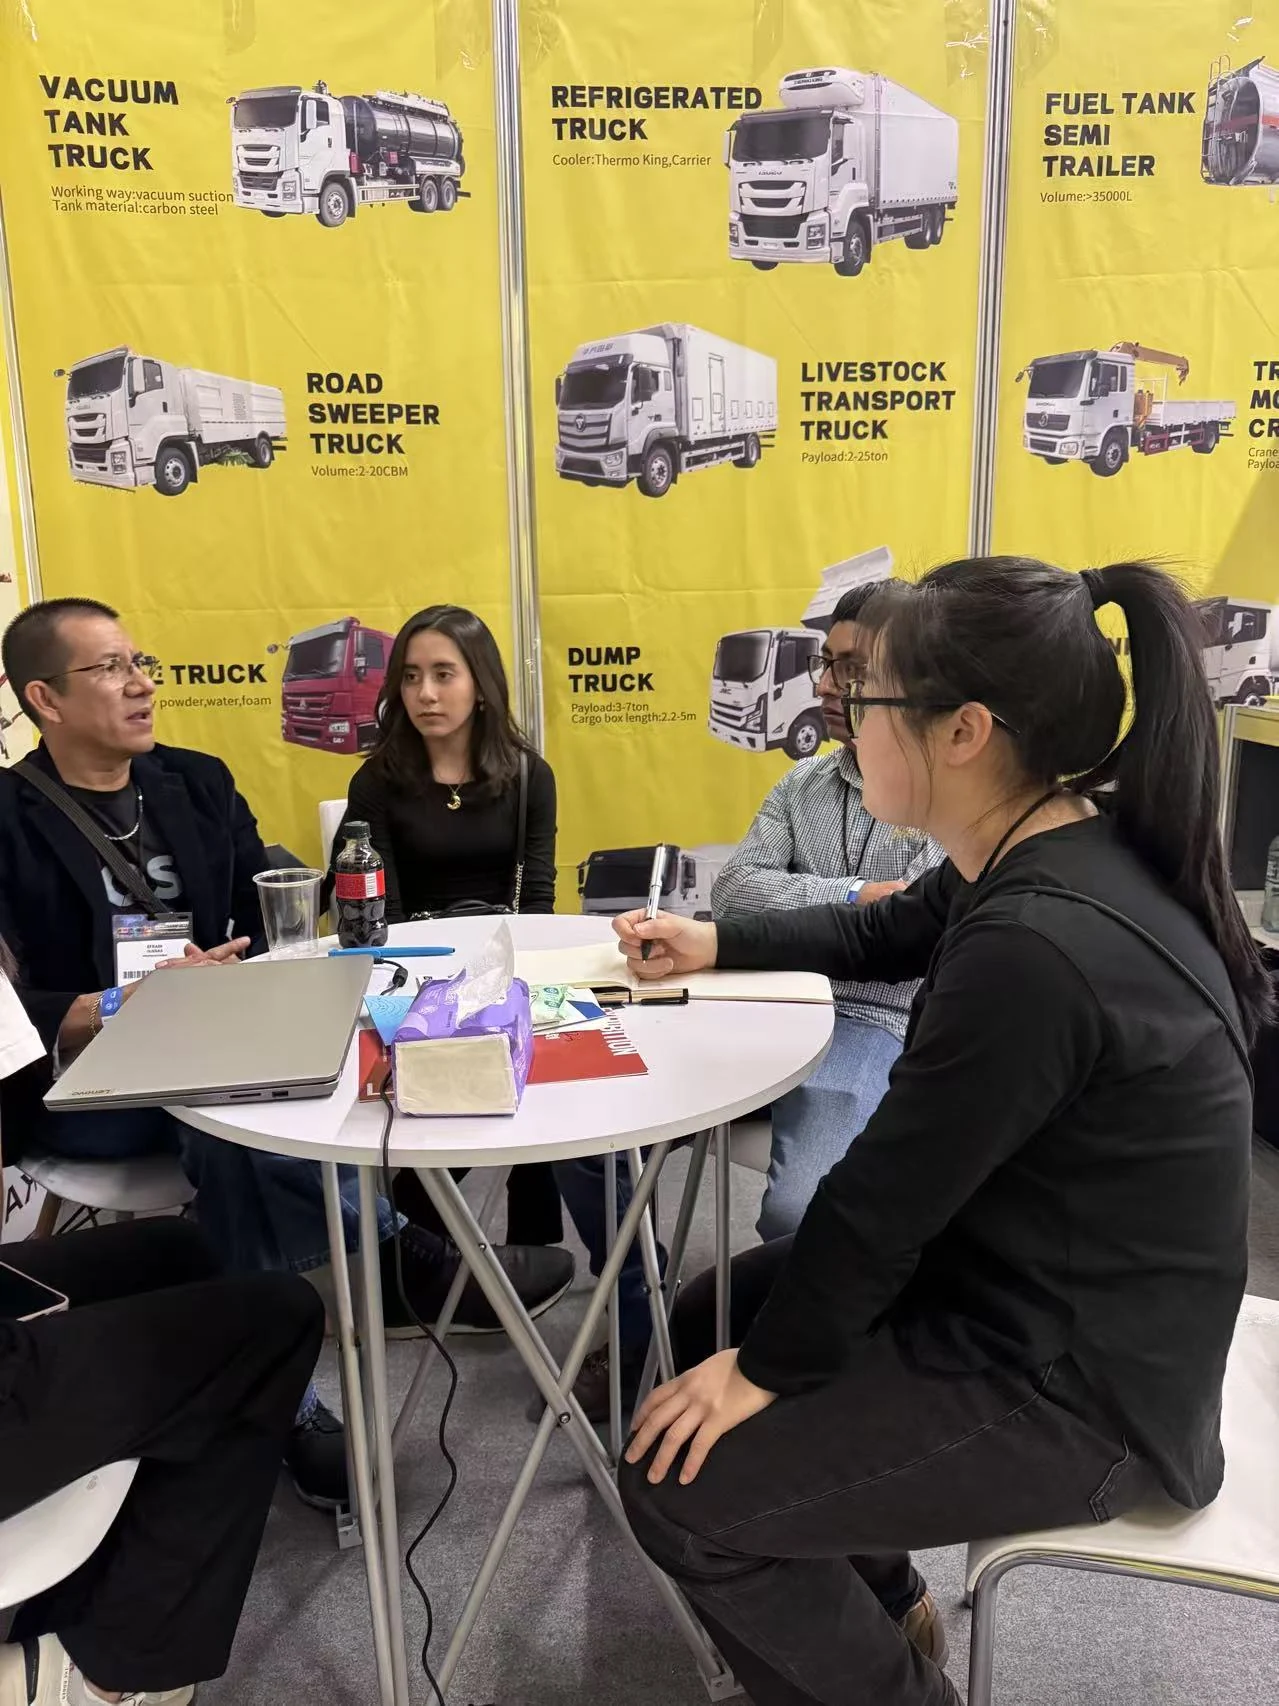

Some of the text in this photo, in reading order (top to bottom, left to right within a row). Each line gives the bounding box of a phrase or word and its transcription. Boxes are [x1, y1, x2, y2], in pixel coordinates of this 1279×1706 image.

[40, 75, 178, 105] VACUUM
[552, 86, 762, 109] REFRIGERATED
[1046, 92, 1196, 114] FUEL TANK
[44, 110, 129, 136] TANK
[552, 118, 648, 141] TRUCK
[1044, 124, 1110, 146] SEMI
[48, 144, 154, 170] TRUCK
[553, 154, 711, 168] Cooler:Thermo King,Carrier
[1043, 155, 1155, 177] TRAILER
[51, 185, 233, 204] Working way:vacuum suction
[1040, 190, 1133, 202] Volume:>35000L
[54, 199, 219, 215] Tank material:carbon steel
[802, 361, 947, 382] LIVESTOCK
[307, 373, 383, 393] ROAD
[801, 391, 956, 411] TRANSPORT
[309, 403, 440, 425] SWEEPER
[801, 420, 888, 440] TRUCK
[1248, 419, 1279, 438] CR
[310, 434, 405, 454] TRUCK
[802, 451, 888, 464] Payload:2-25ton
[312, 466, 408, 477] Volume:2-20CBM
[569, 647, 641, 666] DUMP
[170, 664, 268, 685] TRUCK
[569, 673, 655, 692] TRUCK
[160, 695, 272, 709] powder,water,foam
[571, 703, 649, 714] Payload:3-7ton
[572, 711, 697, 725] Cargo box length:2.2-5m
